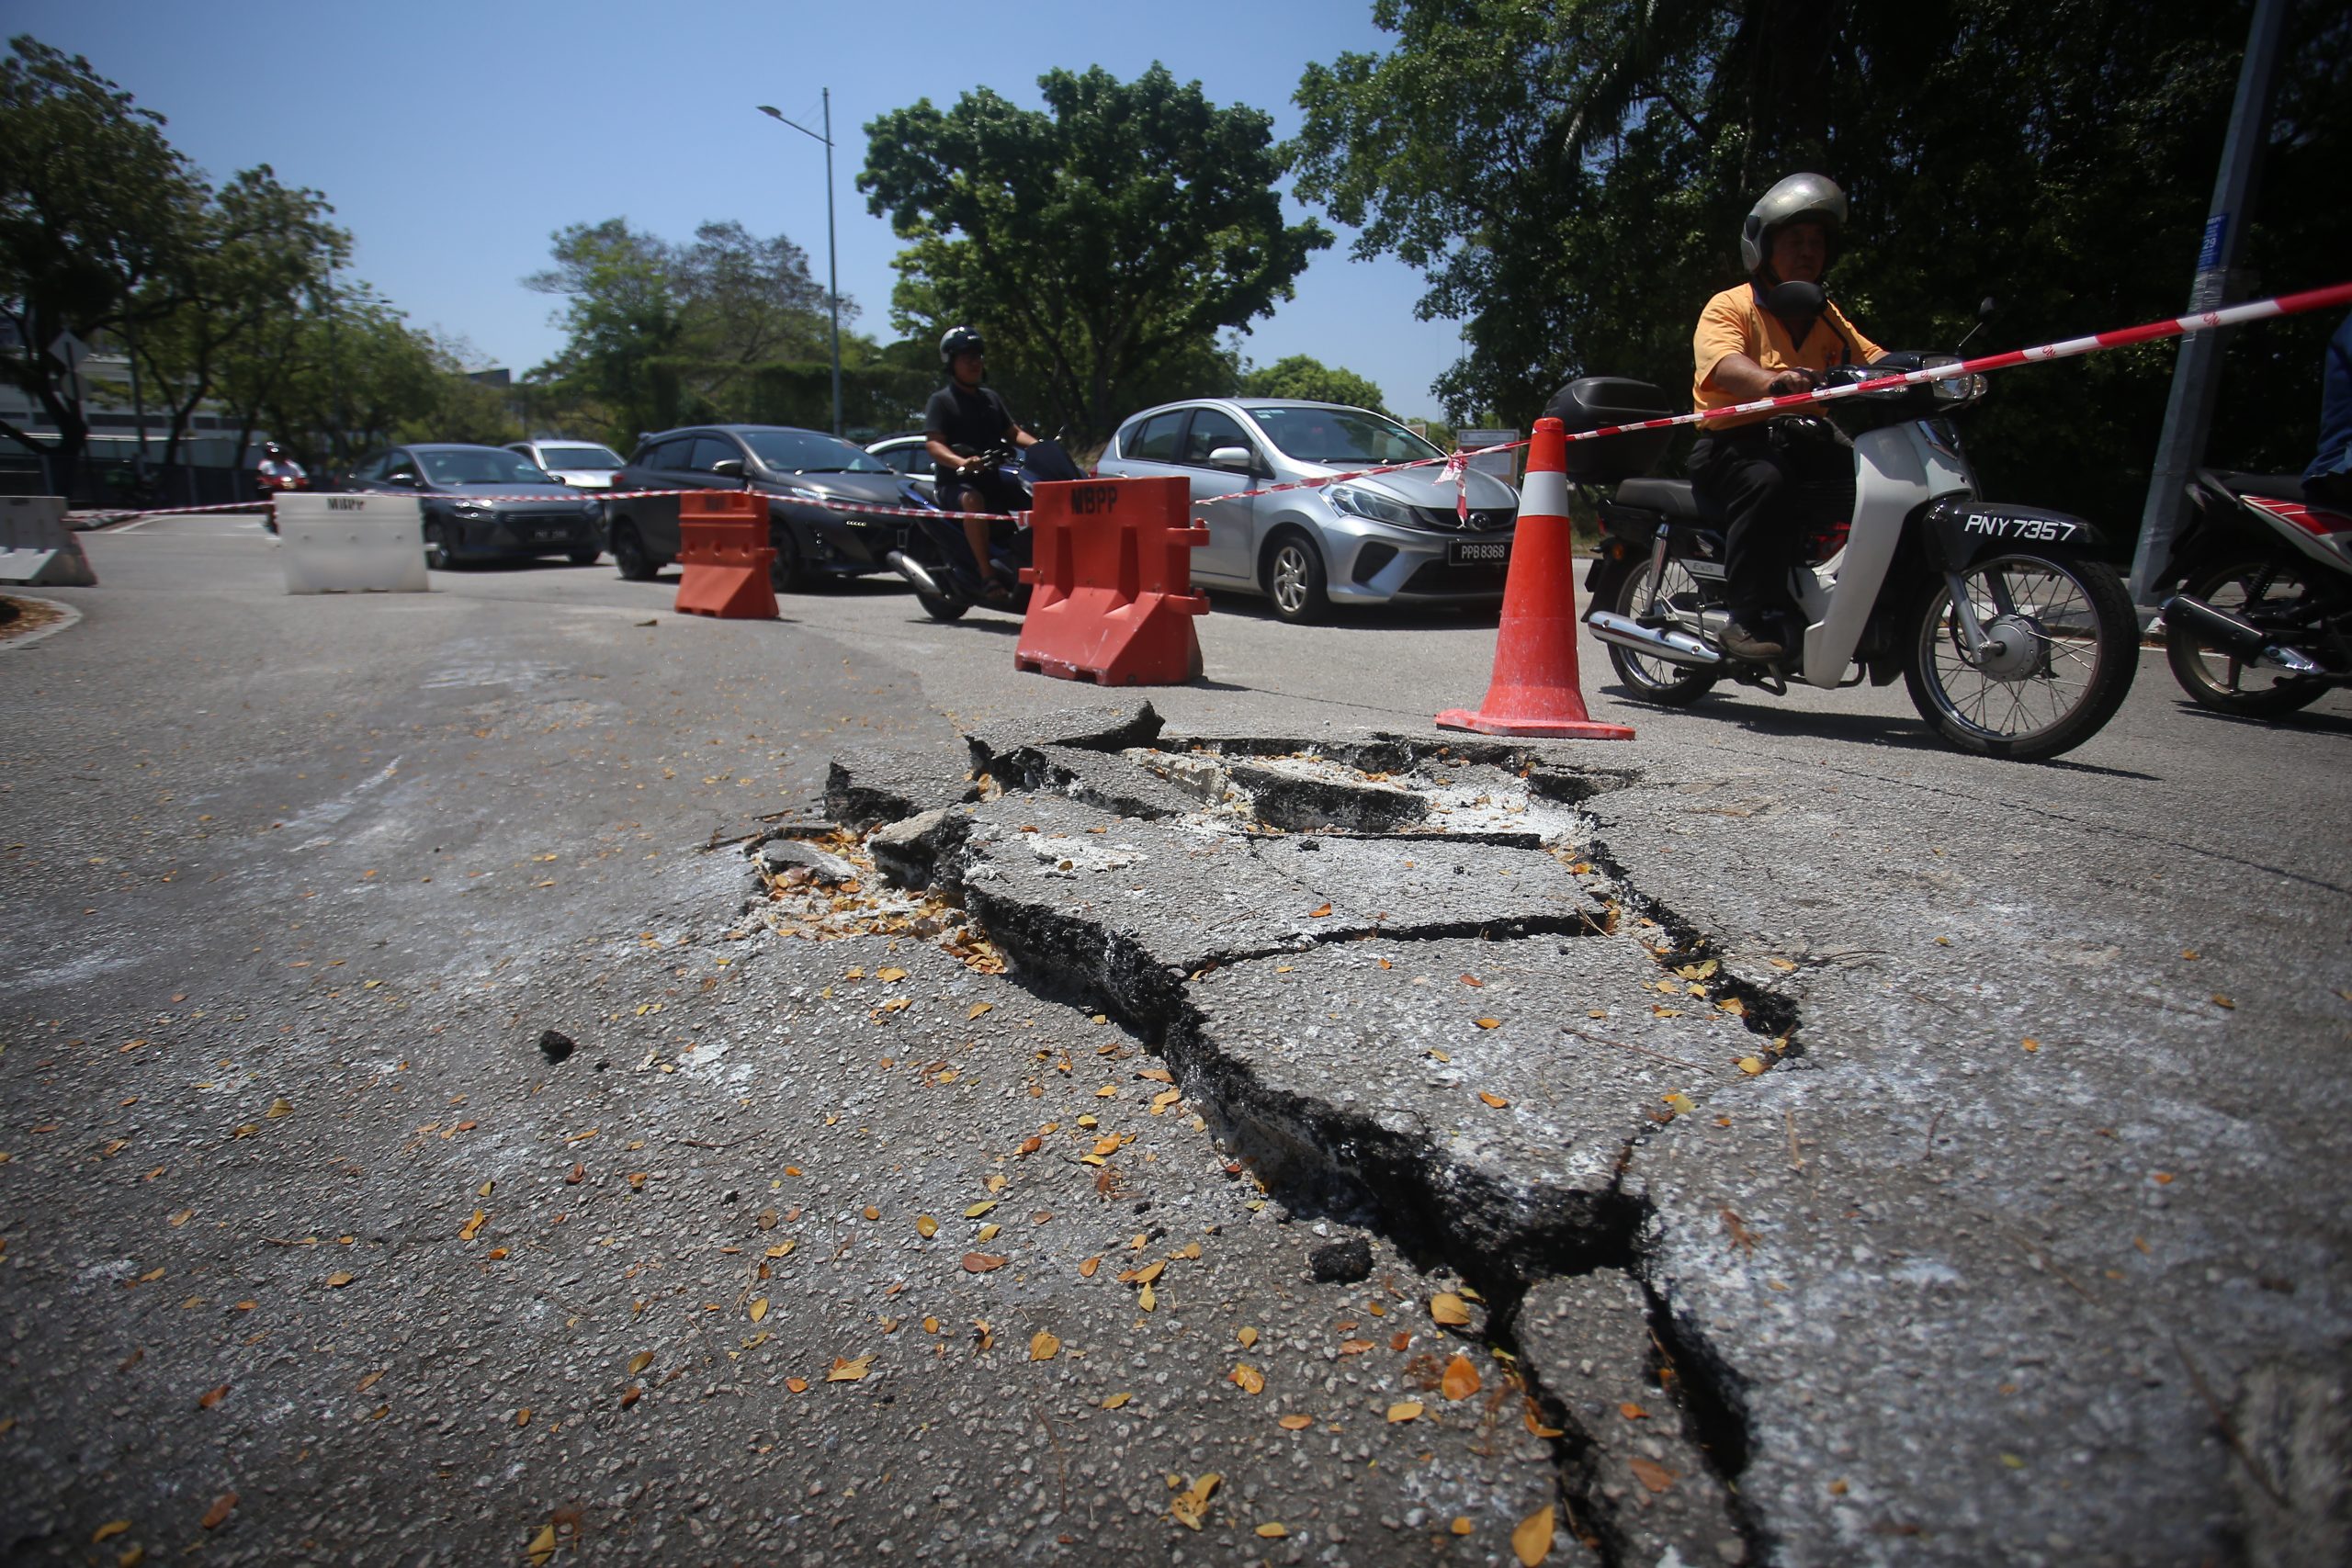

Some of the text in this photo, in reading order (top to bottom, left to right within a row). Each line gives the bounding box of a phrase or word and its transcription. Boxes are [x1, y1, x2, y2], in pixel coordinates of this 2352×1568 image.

[2203, 237, 2217, 250] 29
[1070, 486, 1117, 514] MBPP
[1964, 514, 2076, 541] PNY 7357
[1461, 545, 1505, 558] PPB 8368
